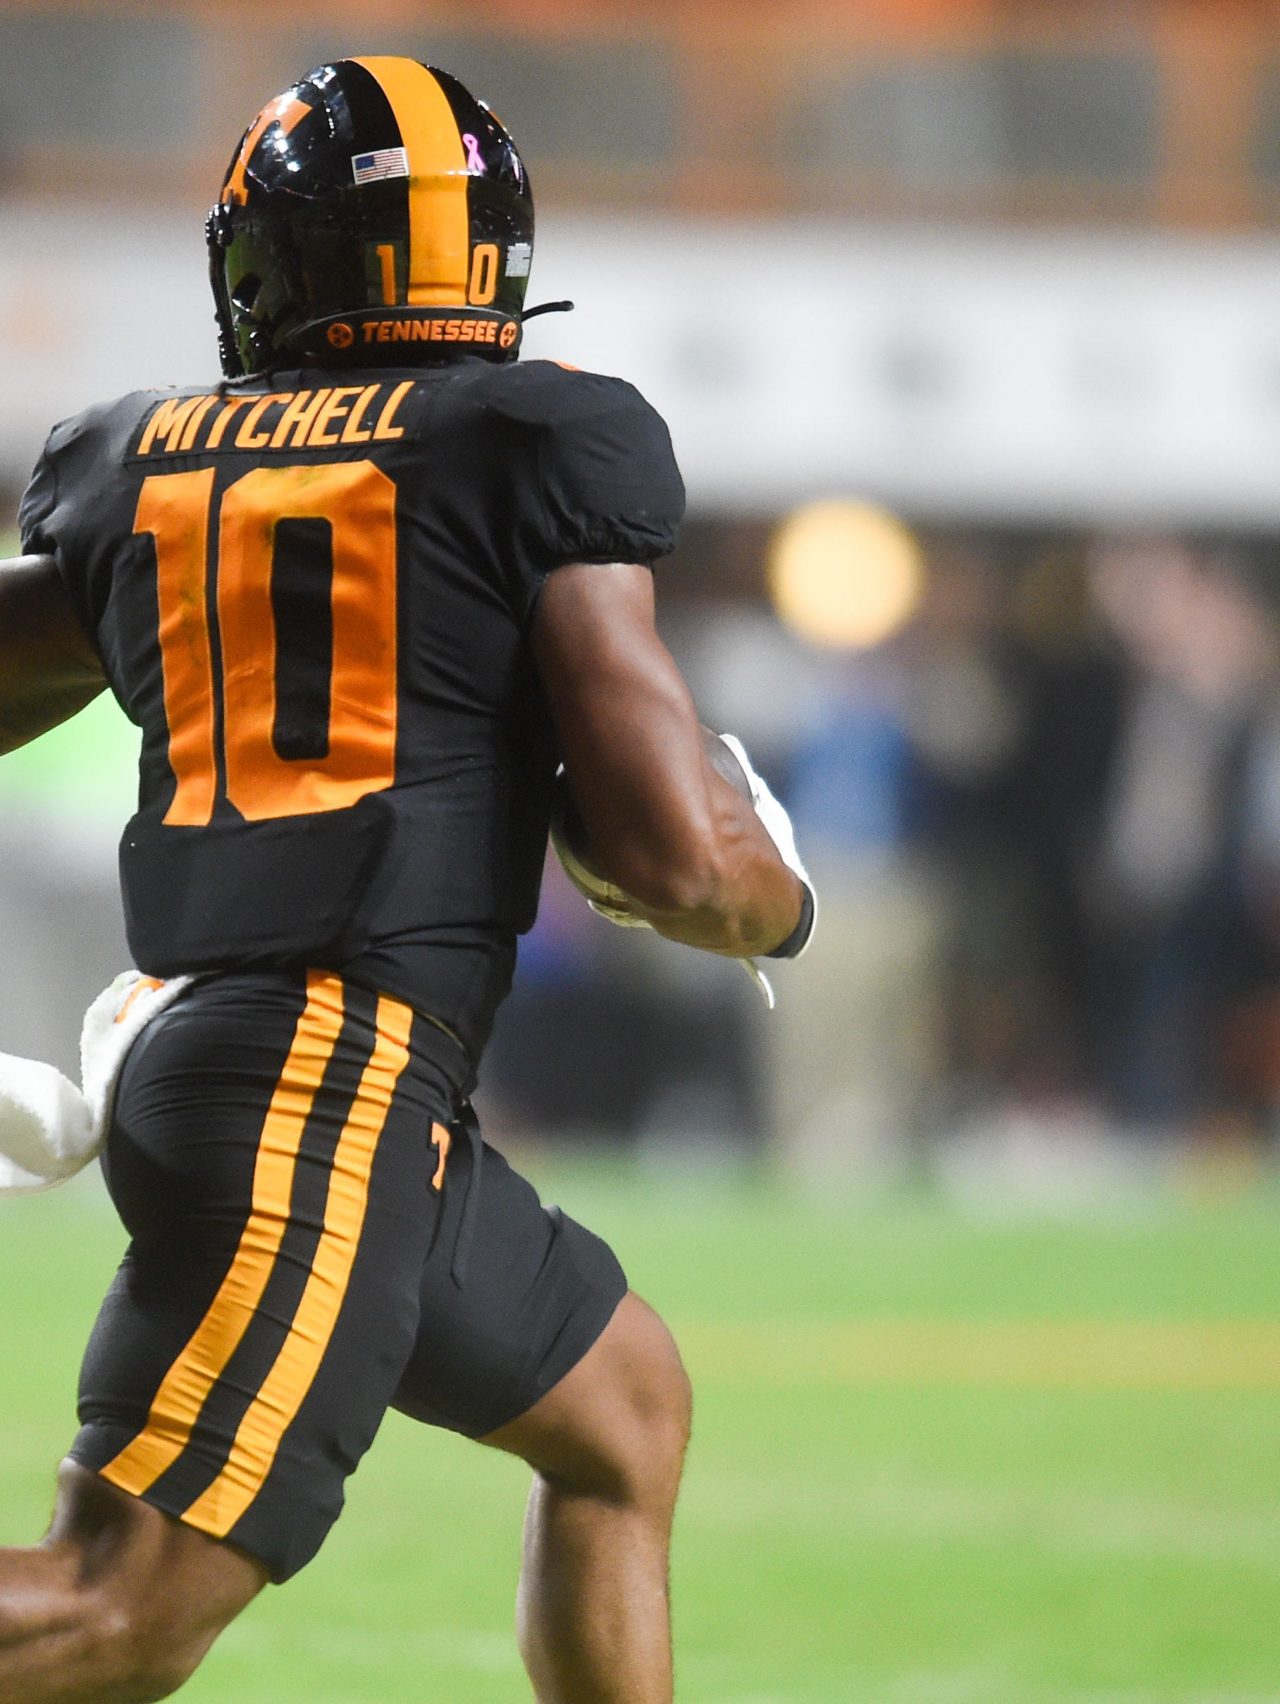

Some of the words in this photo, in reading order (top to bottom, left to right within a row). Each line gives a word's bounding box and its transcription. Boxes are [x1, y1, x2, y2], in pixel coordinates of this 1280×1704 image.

[361, 319, 500, 344] TENNESSEE
[137, 381, 416, 455] MITCHELL
[132, 459, 397, 827] 10
